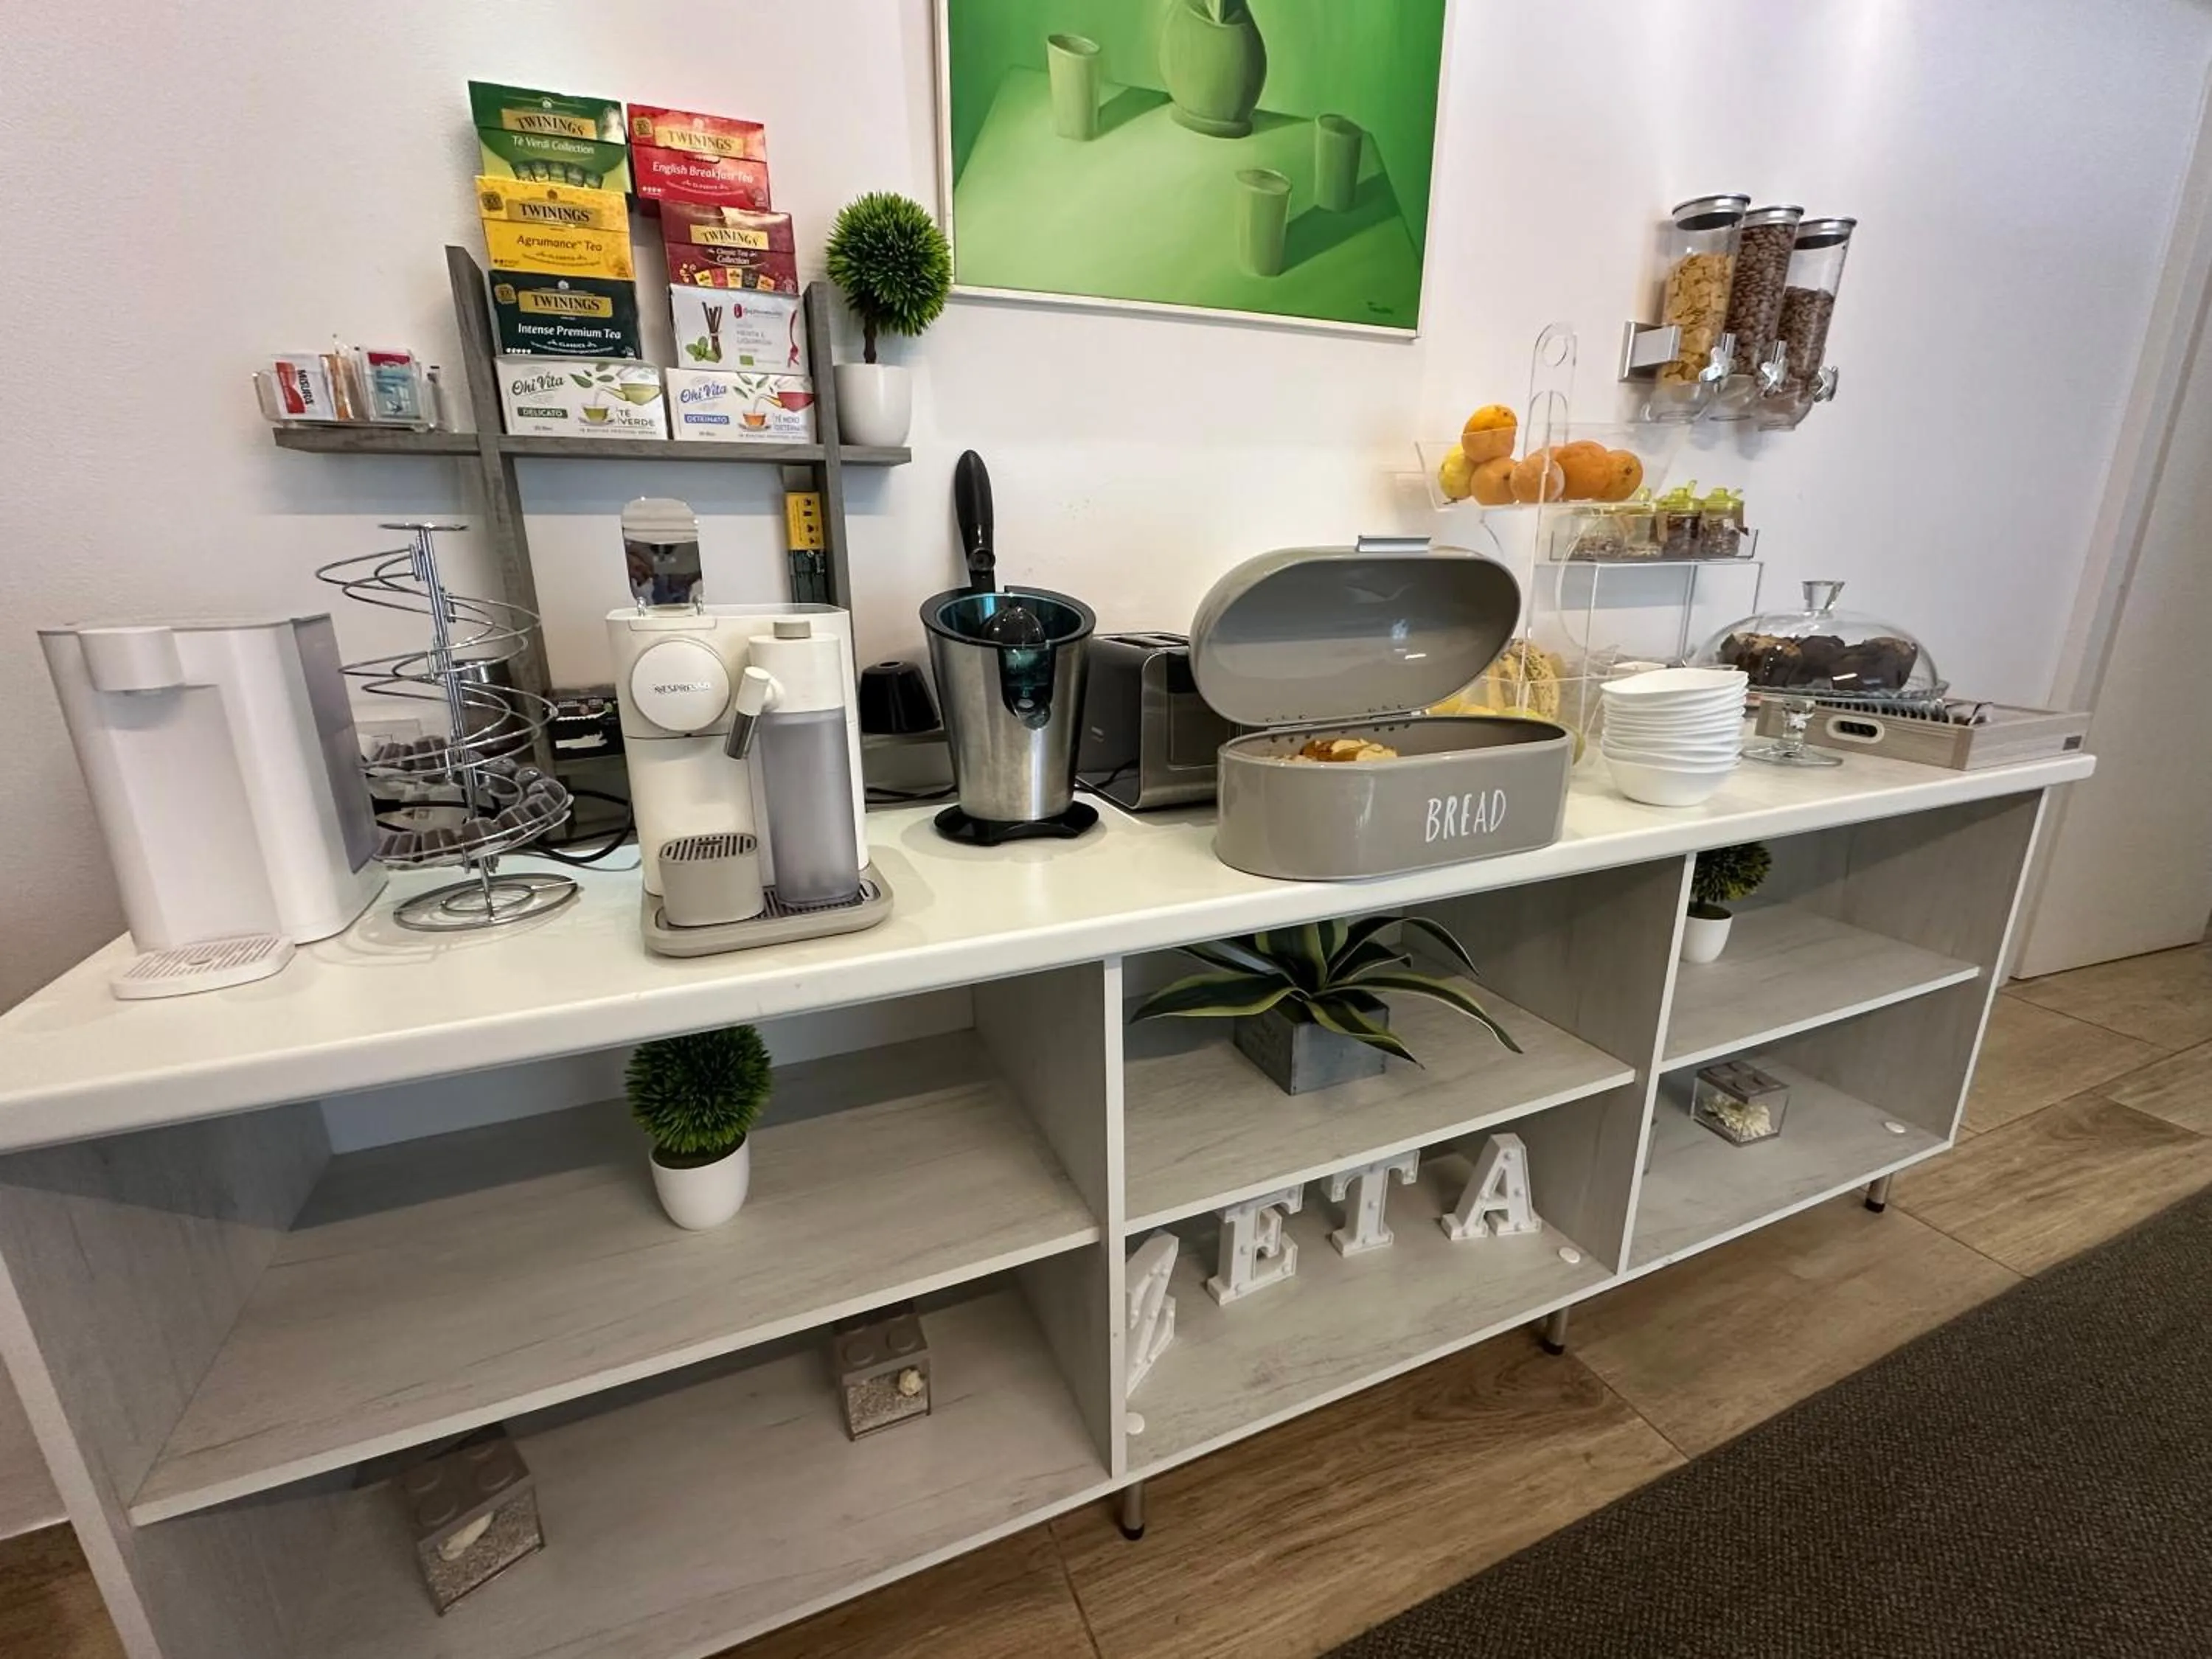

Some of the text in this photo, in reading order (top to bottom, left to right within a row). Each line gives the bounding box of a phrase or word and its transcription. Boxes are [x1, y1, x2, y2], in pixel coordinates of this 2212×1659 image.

[516, 115, 585, 136] TWININGS
[552, 140, 594, 154] Collection
[667, 131, 732, 150] TWININGS
[653, 162, 754, 184] English Breakfast Tea
[519, 203, 591, 222] TWININGS
[585, 240, 602, 251] Tea
[703, 229, 759, 247] TWININGS
[717, 255, 750, 265] Collection
[532, 294, 599, 310] TWININGS
[518, 323, 622, 340] Intense Premium Tea
[522, 408, 563, 417] DELICATO
[620, 418, 655, 427] VERDE
[1425, 789, 1506, 843] BREAD
